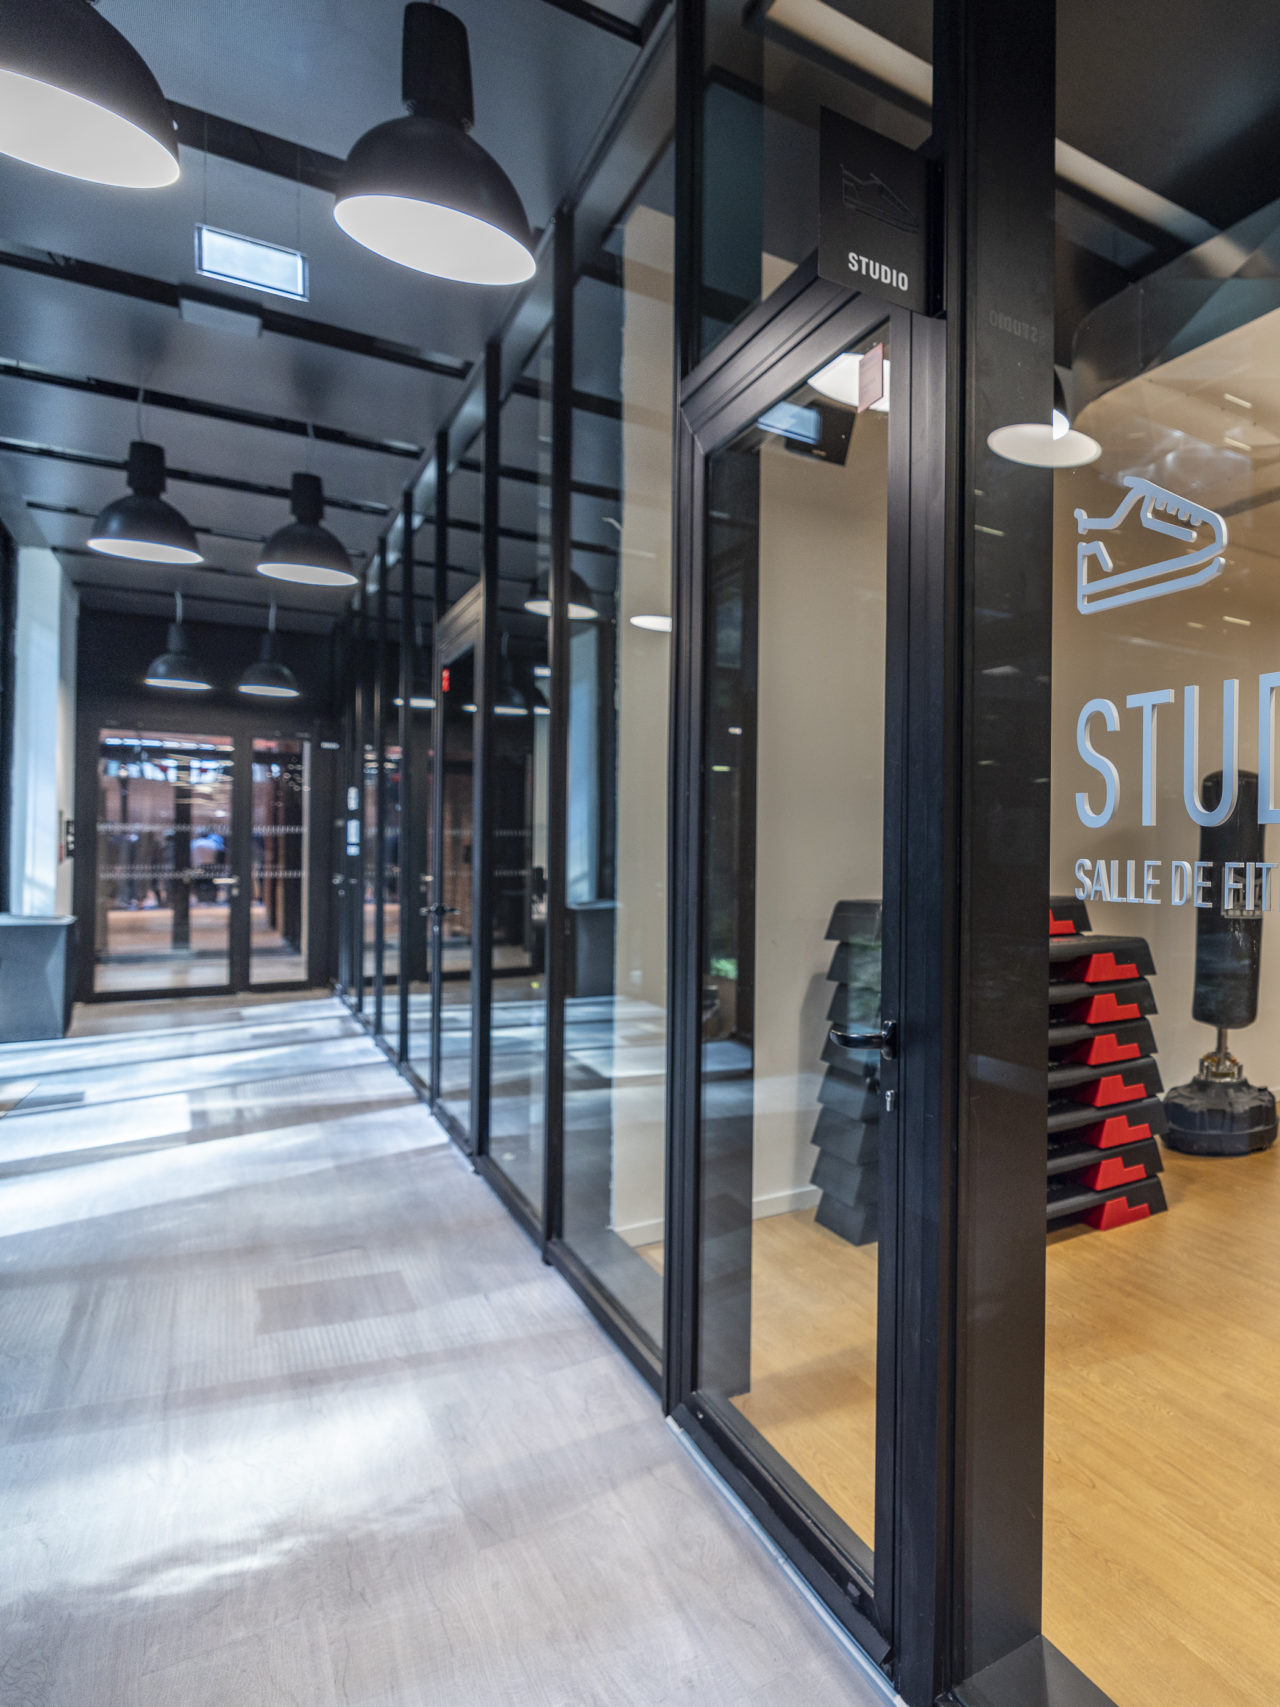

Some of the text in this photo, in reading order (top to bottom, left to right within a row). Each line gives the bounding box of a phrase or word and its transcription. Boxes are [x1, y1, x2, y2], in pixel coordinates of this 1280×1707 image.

[848, 252, 908, 291] STUDIO
[1075, 858, 1162, 904] SALLE
[1171, 861, 1214, 908] DE
